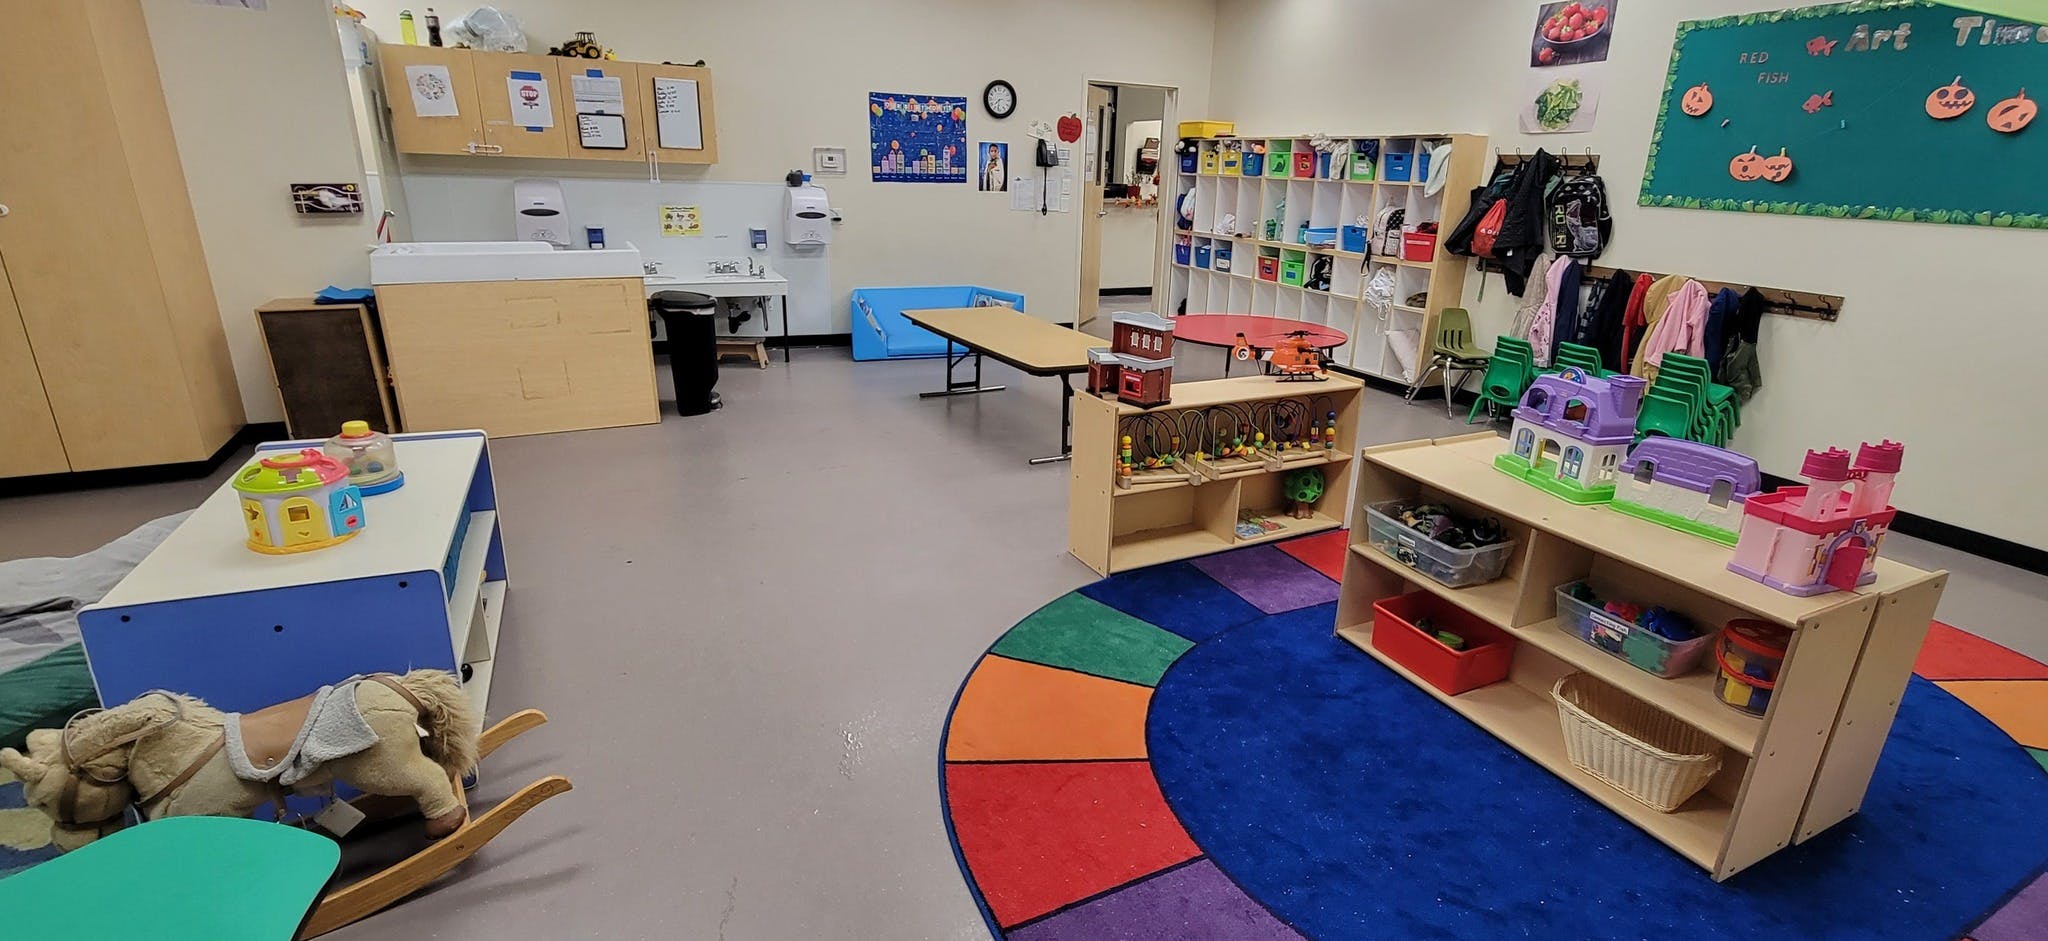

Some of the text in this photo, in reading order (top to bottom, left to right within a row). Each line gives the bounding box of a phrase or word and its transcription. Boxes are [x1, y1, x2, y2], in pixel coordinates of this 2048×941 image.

[1844, 22, 1912, 51] Art
[1739, 51, 1769, 64] RED
[1757, 72, 1789, 84] FISH
